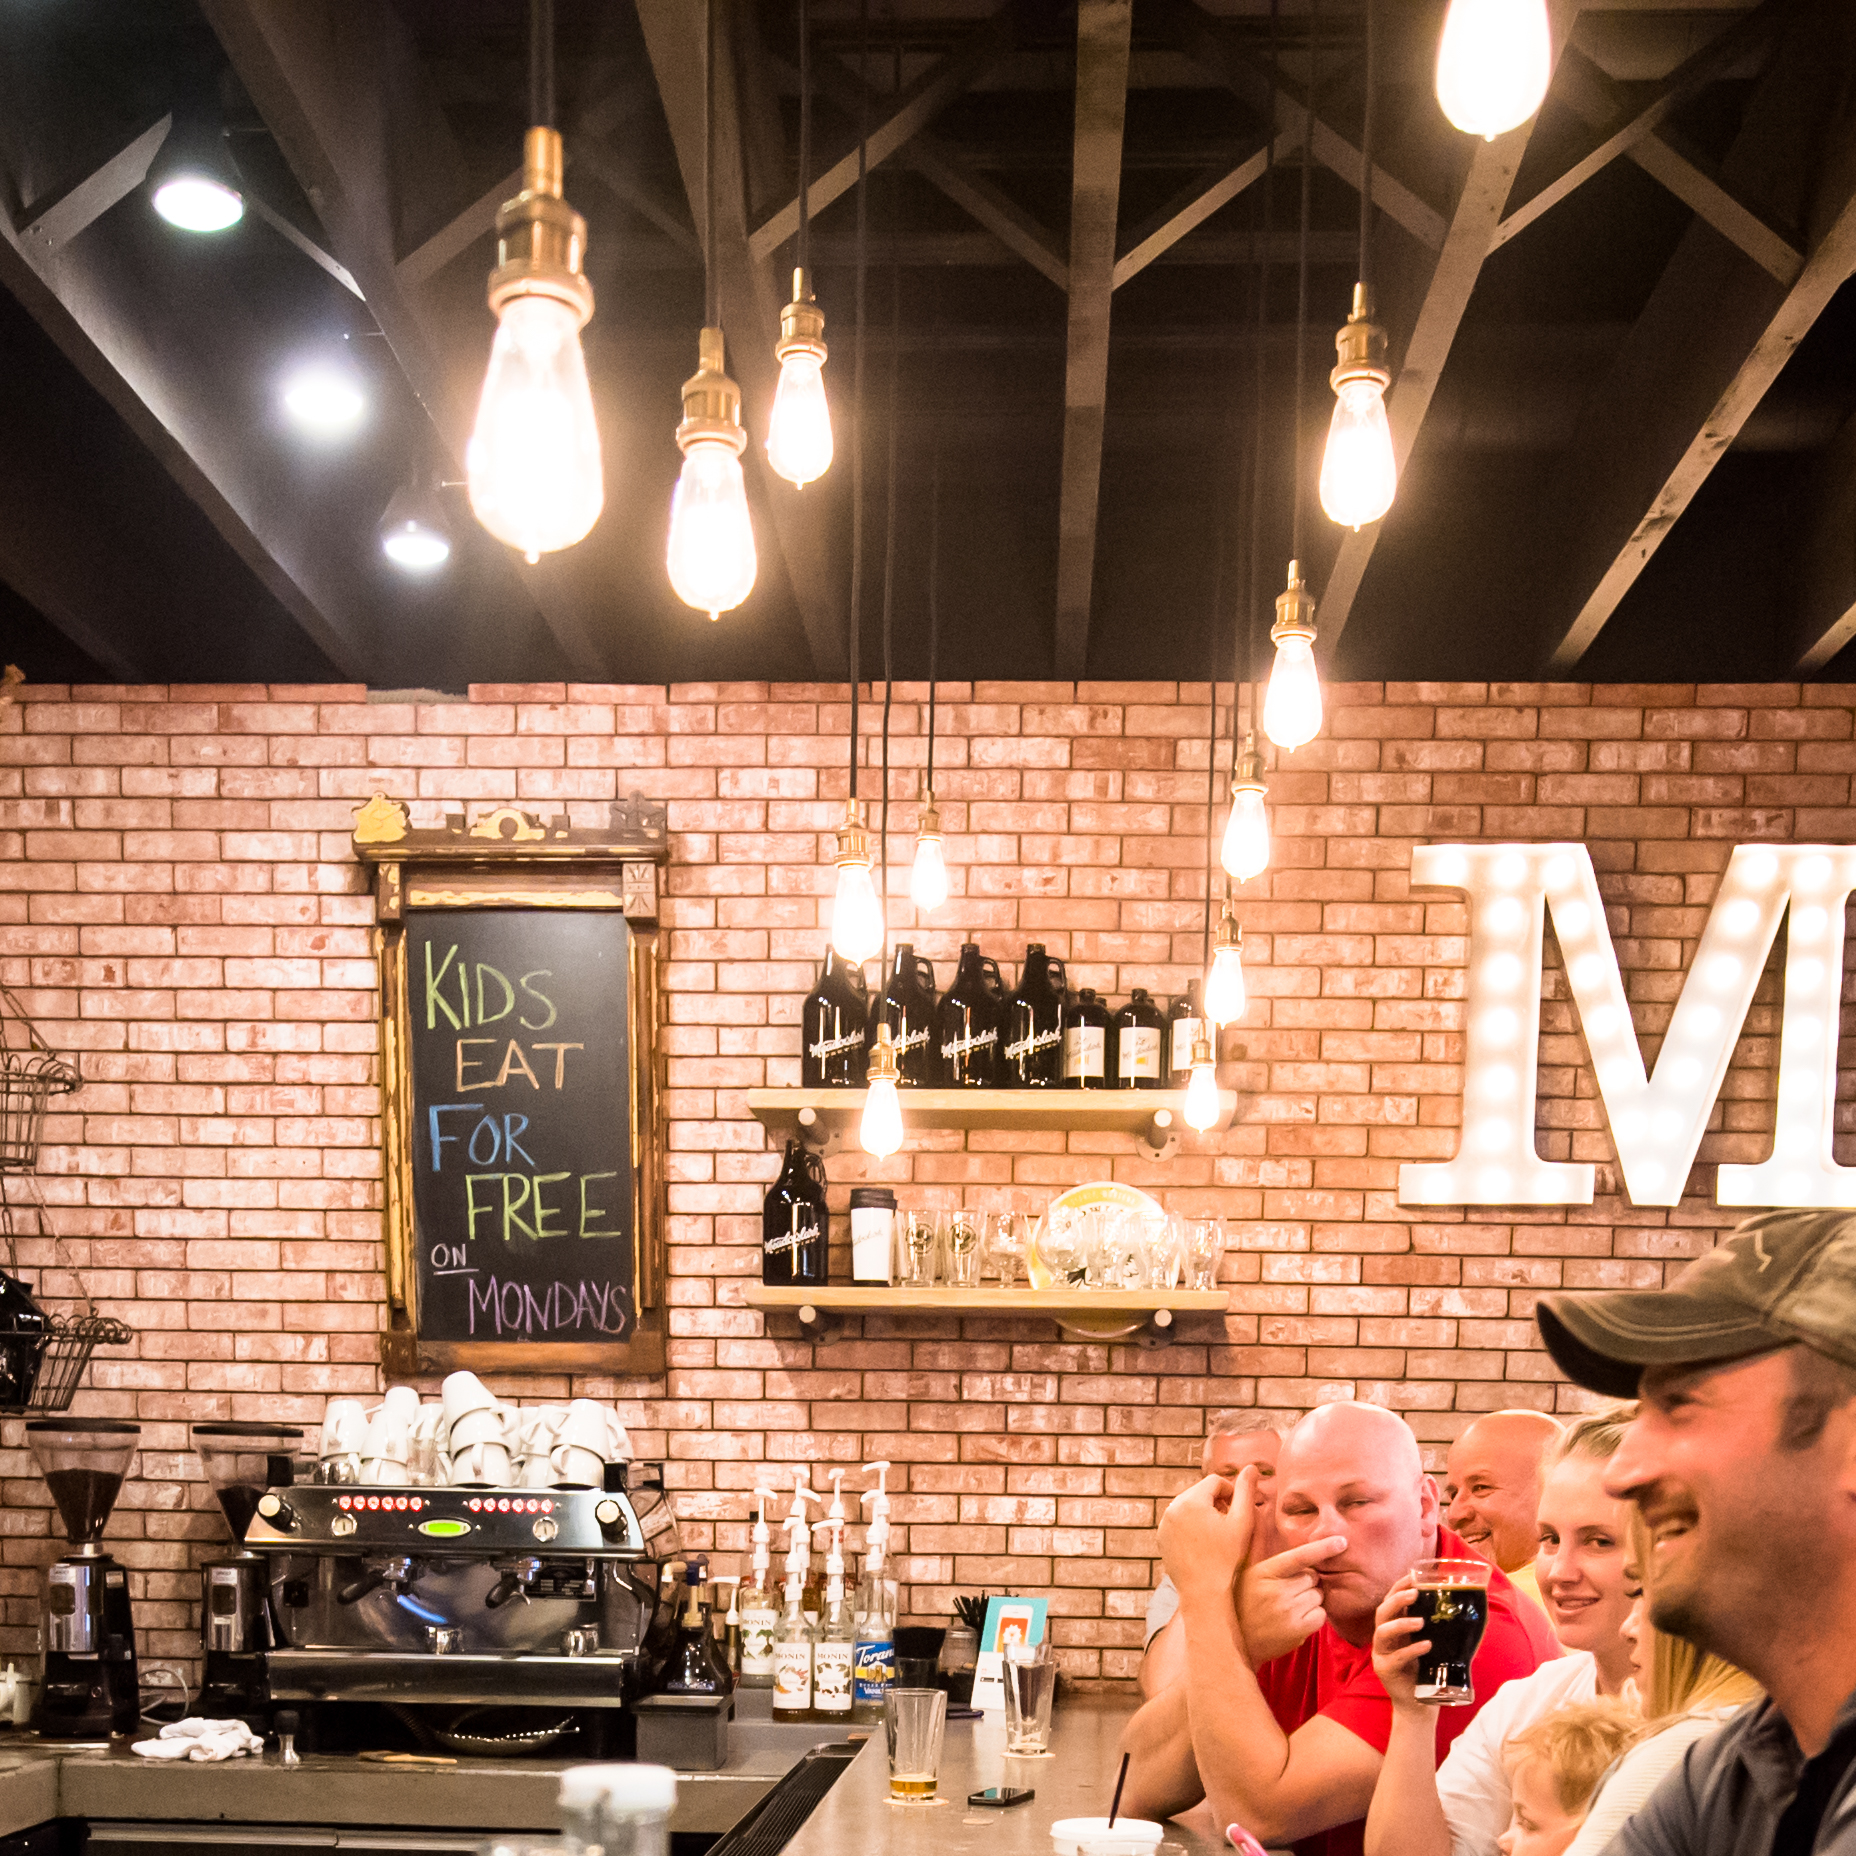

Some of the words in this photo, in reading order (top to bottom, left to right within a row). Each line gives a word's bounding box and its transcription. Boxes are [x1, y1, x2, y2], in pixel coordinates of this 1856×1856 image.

[424, 940, 559, 1032] KIDS
[455, 1037, 585, 1093] EAT
[428, 1102, 539, 1172] FOR
[464, 1170, 622, 1242] FREE
[430, 1242, 468, 1269] ON
[467, 1274, 629, 1336] MONDAYS
